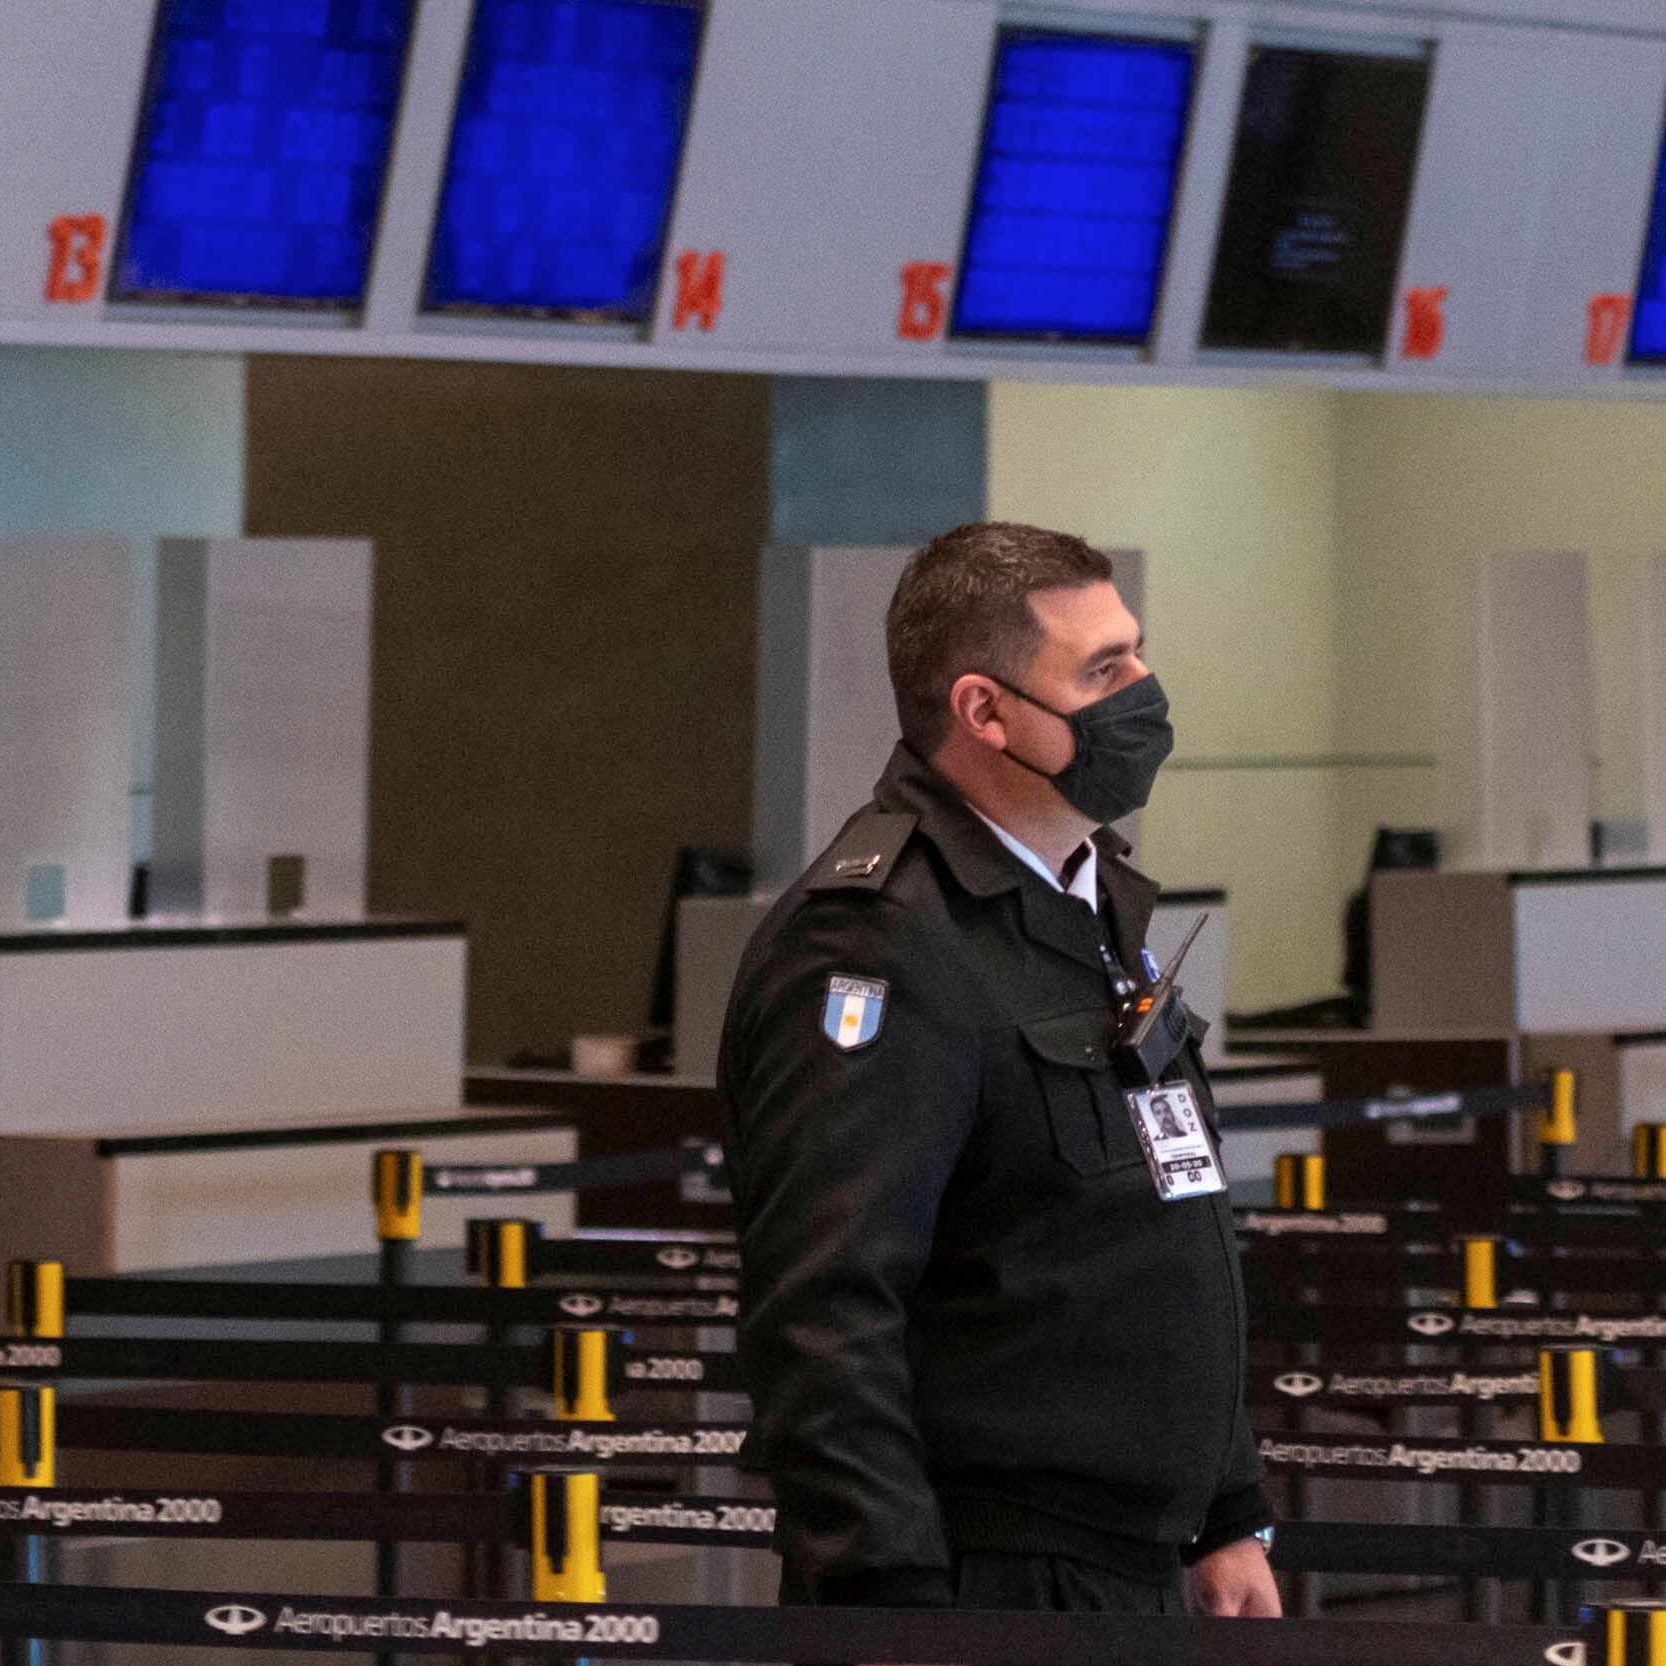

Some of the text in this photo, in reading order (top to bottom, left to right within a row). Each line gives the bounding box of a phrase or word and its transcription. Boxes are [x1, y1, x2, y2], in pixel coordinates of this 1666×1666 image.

[45, 213, 107, 304] 13
[672, 249, 726, 331] 14
[897, 261, 952, 341] 15
[569, 1430, 693, 1459] Argentina
[1390, 1443, 1519, 1475] Argentina
[1518, 1449, 1582, 1473] 2000
[21, 1496, 156, 1527] Argentina
[156, 1498, 223, 1523] 2000
[600, 1501, 717, 1532] rgentina
[271, 1606, 659, 1648] Aeropuertos Argentina 2000
